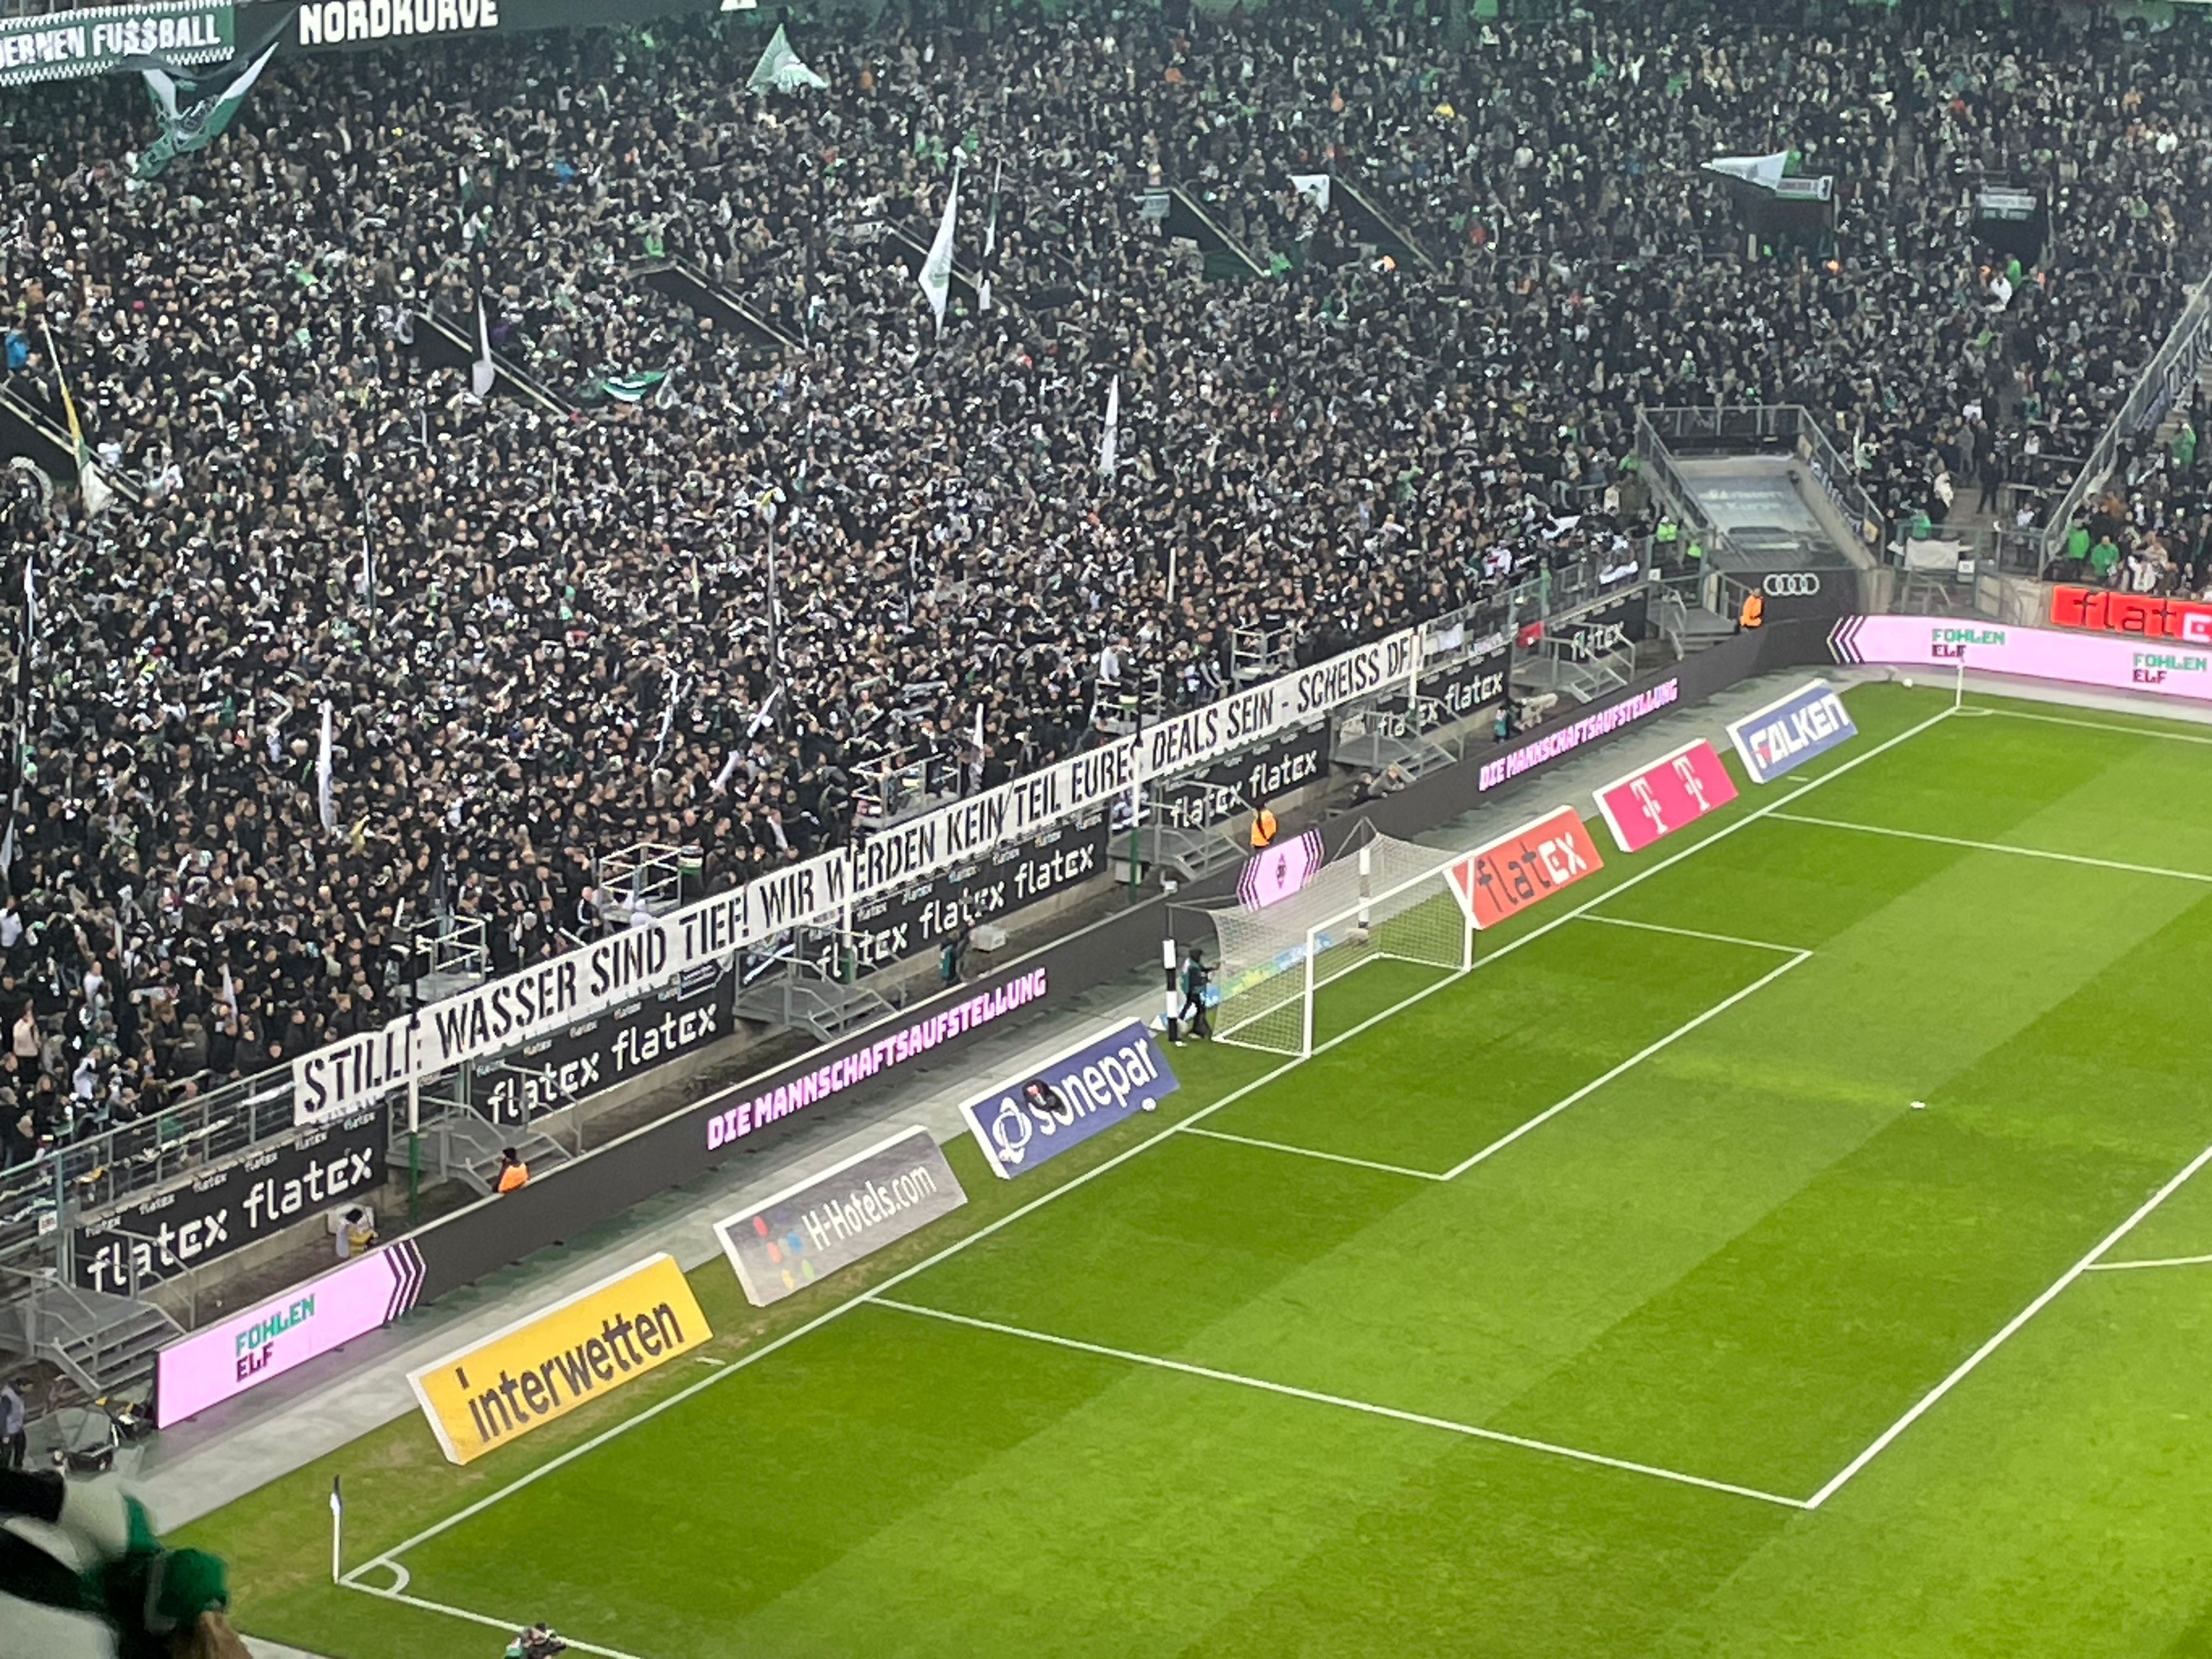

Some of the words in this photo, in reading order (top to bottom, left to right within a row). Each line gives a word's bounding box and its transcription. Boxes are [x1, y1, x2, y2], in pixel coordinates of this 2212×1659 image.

[299, 0, 498, 45] NORDKURVE
[0, 26, 86, 69] ERNEN
[1932, 628, 2006, 645] FOHLEN
[1932, 644, 1966, 658] ELF
[2133, 653, 2208, 671] FOHLEN
[2133, 669, 2167, 684] ELF
[1749, 692, 1850, 769] FALKEN
[1479, 758, 1506, 792] DIE
[435, 961, 577, 1060] WASSER
[591, 926, 666, 997] SIND
[679, 891, 749, 960] TIEF!
[759, 868, 815, 929] WIR
[826, 821, 935, 903] WERDEN
[947, 793, 1004, 855] KEIN
[1014, 771, 1061, 827] TEIL
[1152, 708, 1218, 771] DEALS
[1227, 690, 1272, 739] SEIN
[1297, 648, 1380, 713] SCHEISS
[816, 922, 908, 983] fltex
[708, 1102, 751, 1150] DIE
[754, 967, 1047, 1129] MANNSCHAFTSAUFSTELLUNG
[801, 1165, 937, 1251] H-Hotels.com
[235, 1292, 316, 1358] FOHLEN
[236, 1342, 274, 1383] ELF
[455, 1301, 685, 1443] interwetten
